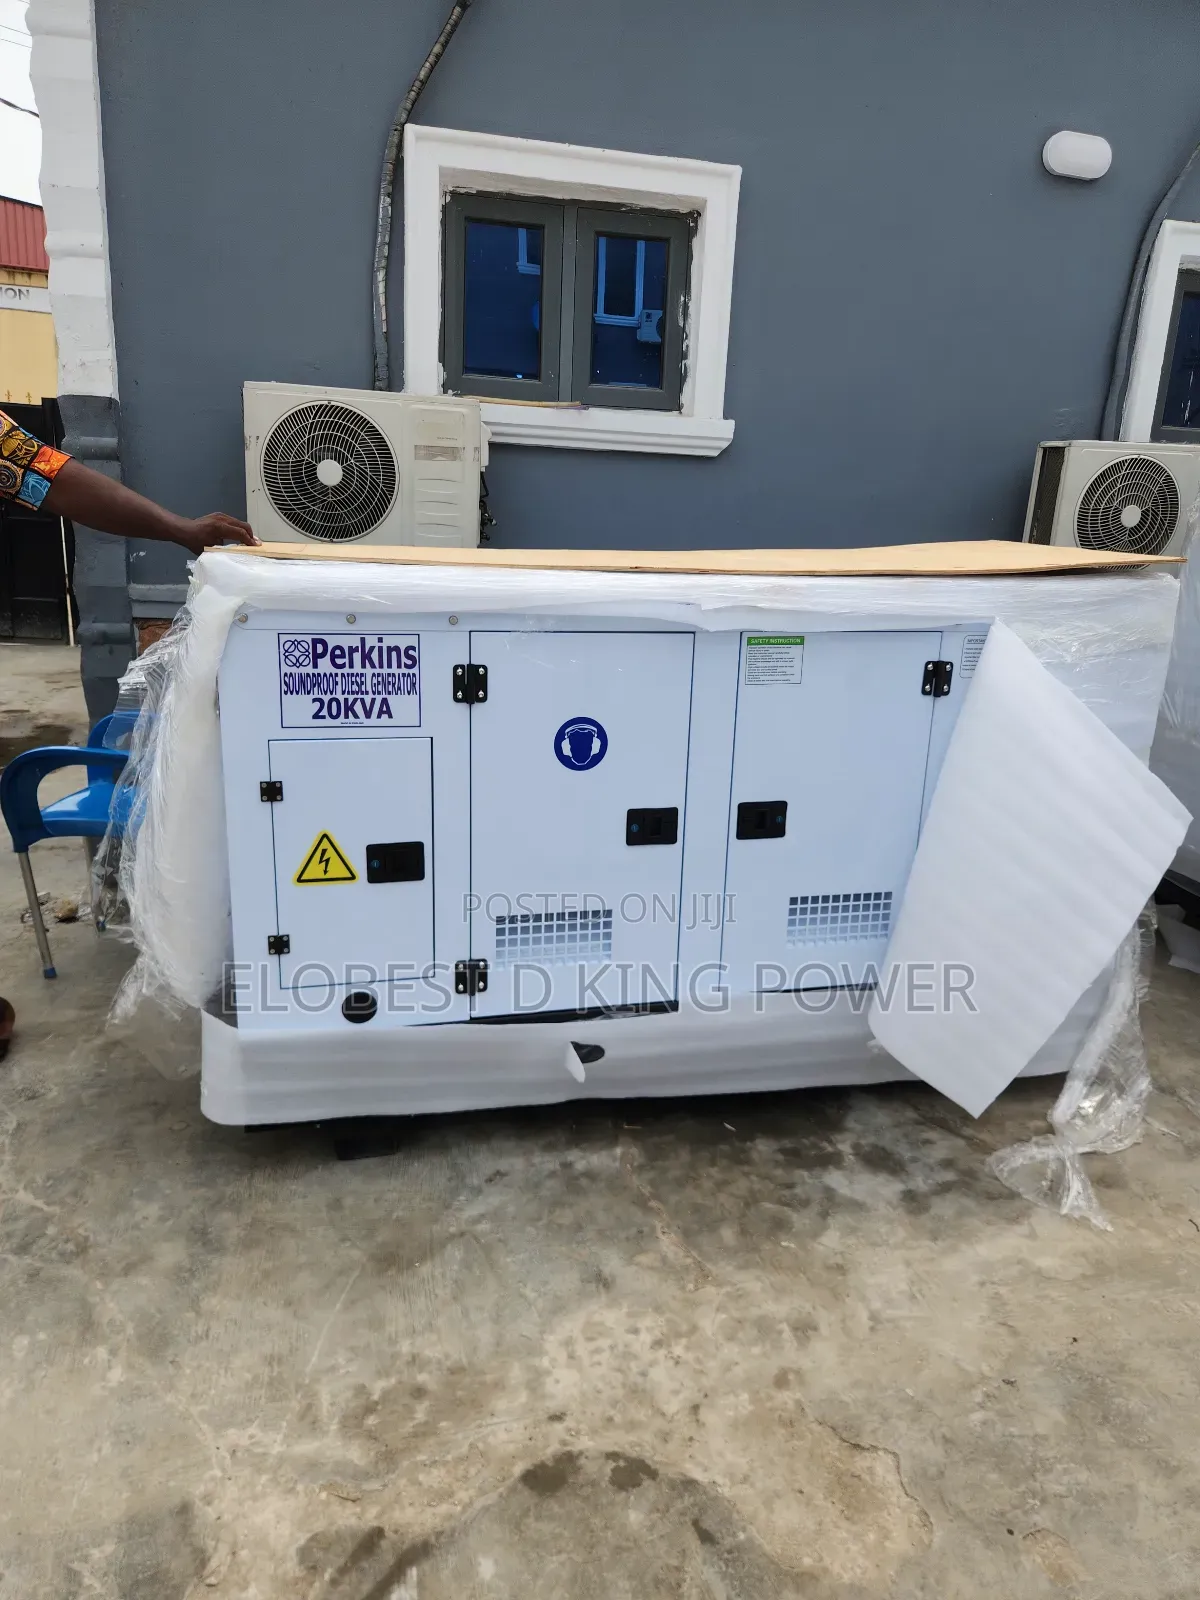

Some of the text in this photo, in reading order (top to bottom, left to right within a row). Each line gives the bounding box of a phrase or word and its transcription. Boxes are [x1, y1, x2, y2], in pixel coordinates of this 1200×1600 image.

[311, 636, 418, 670] Perkins
[283, 672, 418, 696] SOUNDPROOF DIESEL GENERATOR
[311, 697, 394, 720] 20KVA
